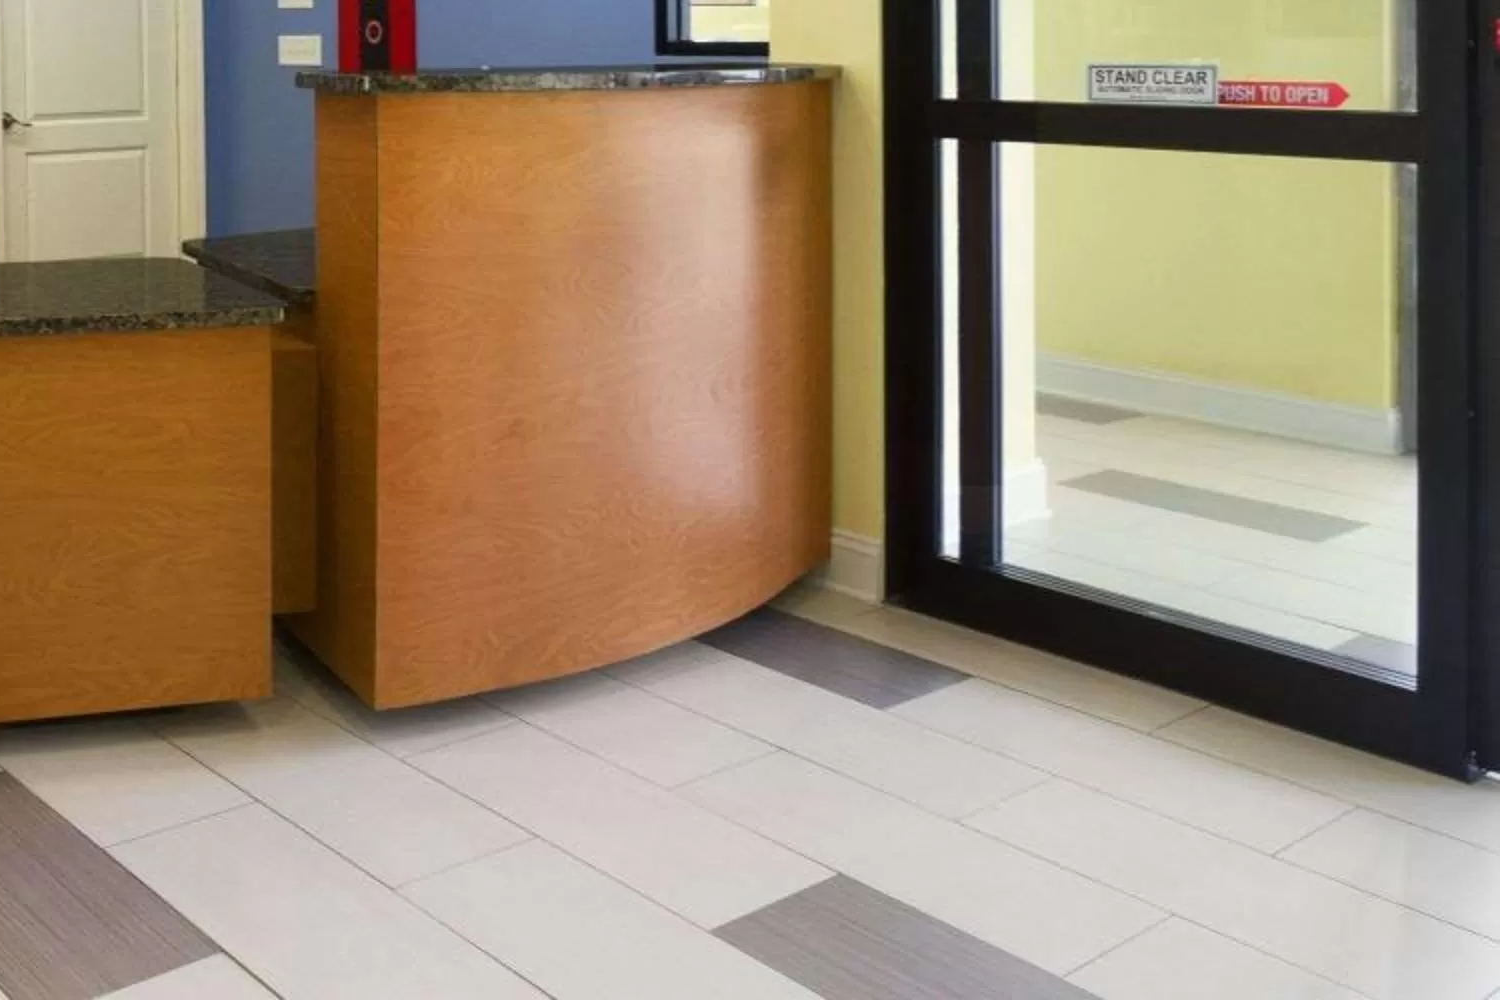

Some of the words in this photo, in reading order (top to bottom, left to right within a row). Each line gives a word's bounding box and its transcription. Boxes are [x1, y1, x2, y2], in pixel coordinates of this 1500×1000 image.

[1095, 69, 1147, 85] STAND
[1152, 69, 1208, 85] CLEAR
[1260, 85, 1281, 103] TO
[1285, 86, 1329, 104] OPEN
